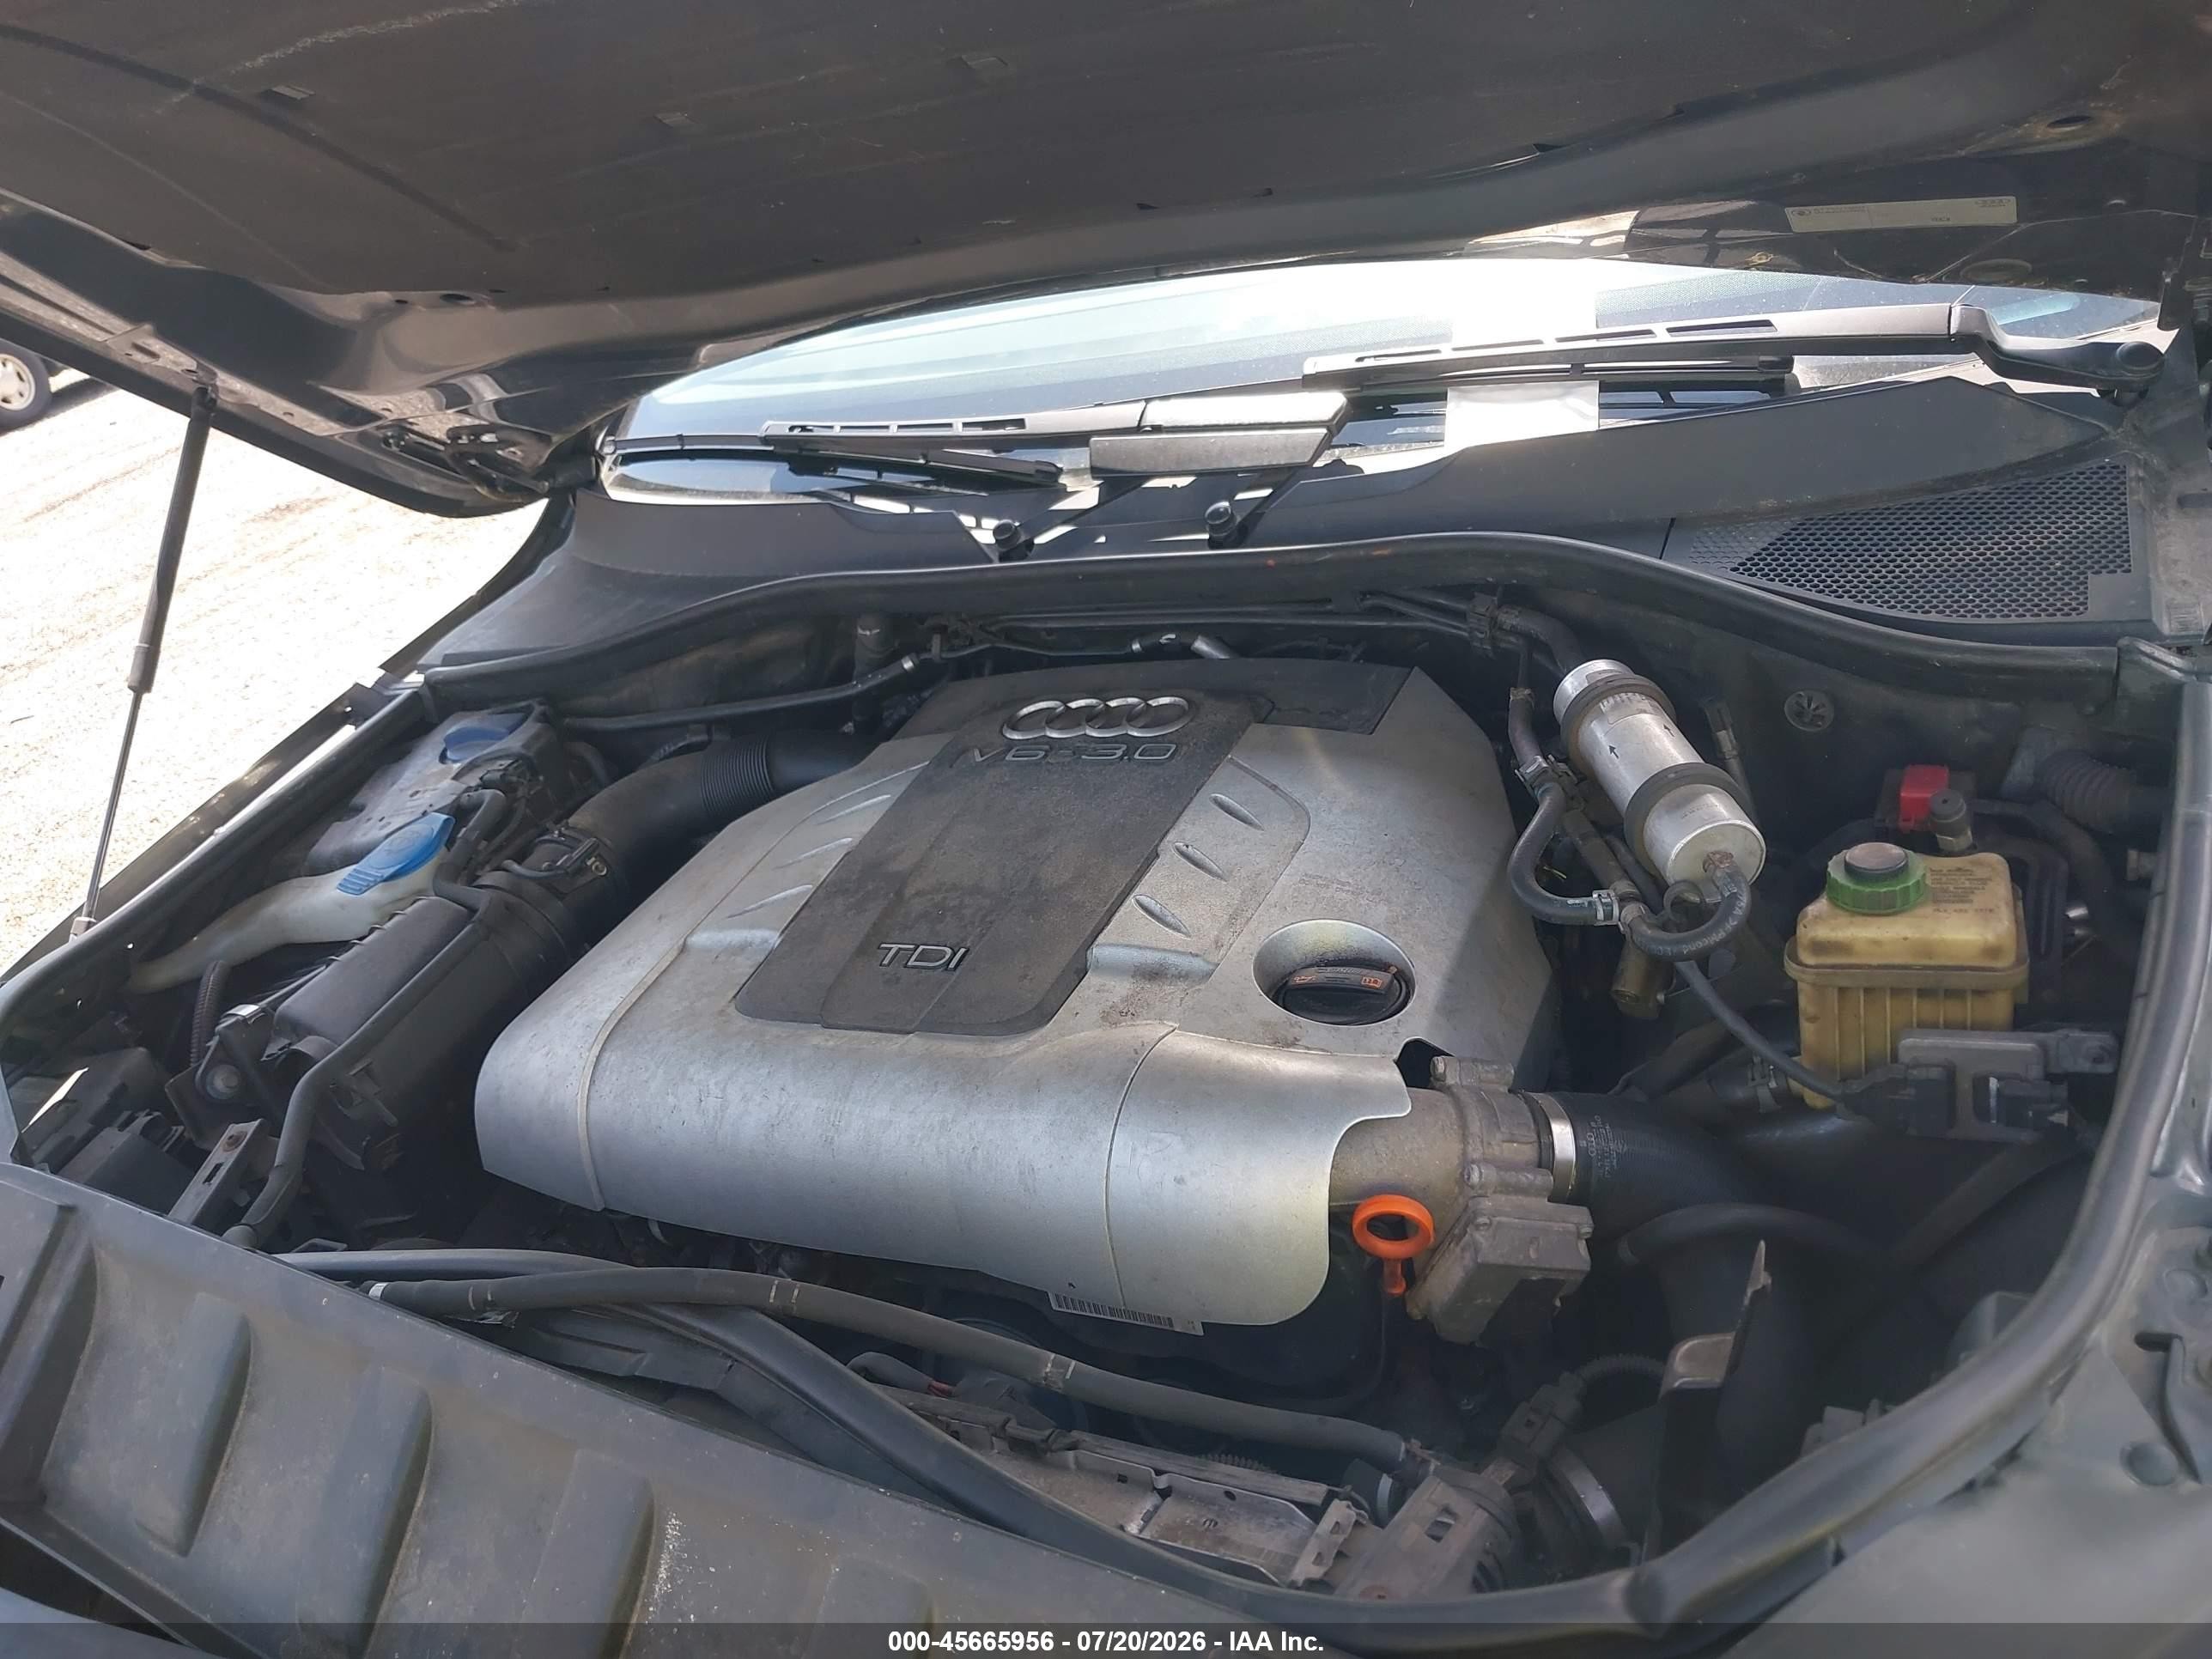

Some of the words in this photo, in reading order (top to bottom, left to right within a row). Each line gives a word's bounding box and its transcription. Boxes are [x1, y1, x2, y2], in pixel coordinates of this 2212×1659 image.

[973, 744, 1050, 763] V6
[1079, 743, 1177, 761] 3.0
[878, 943, 969, 970] TDI
